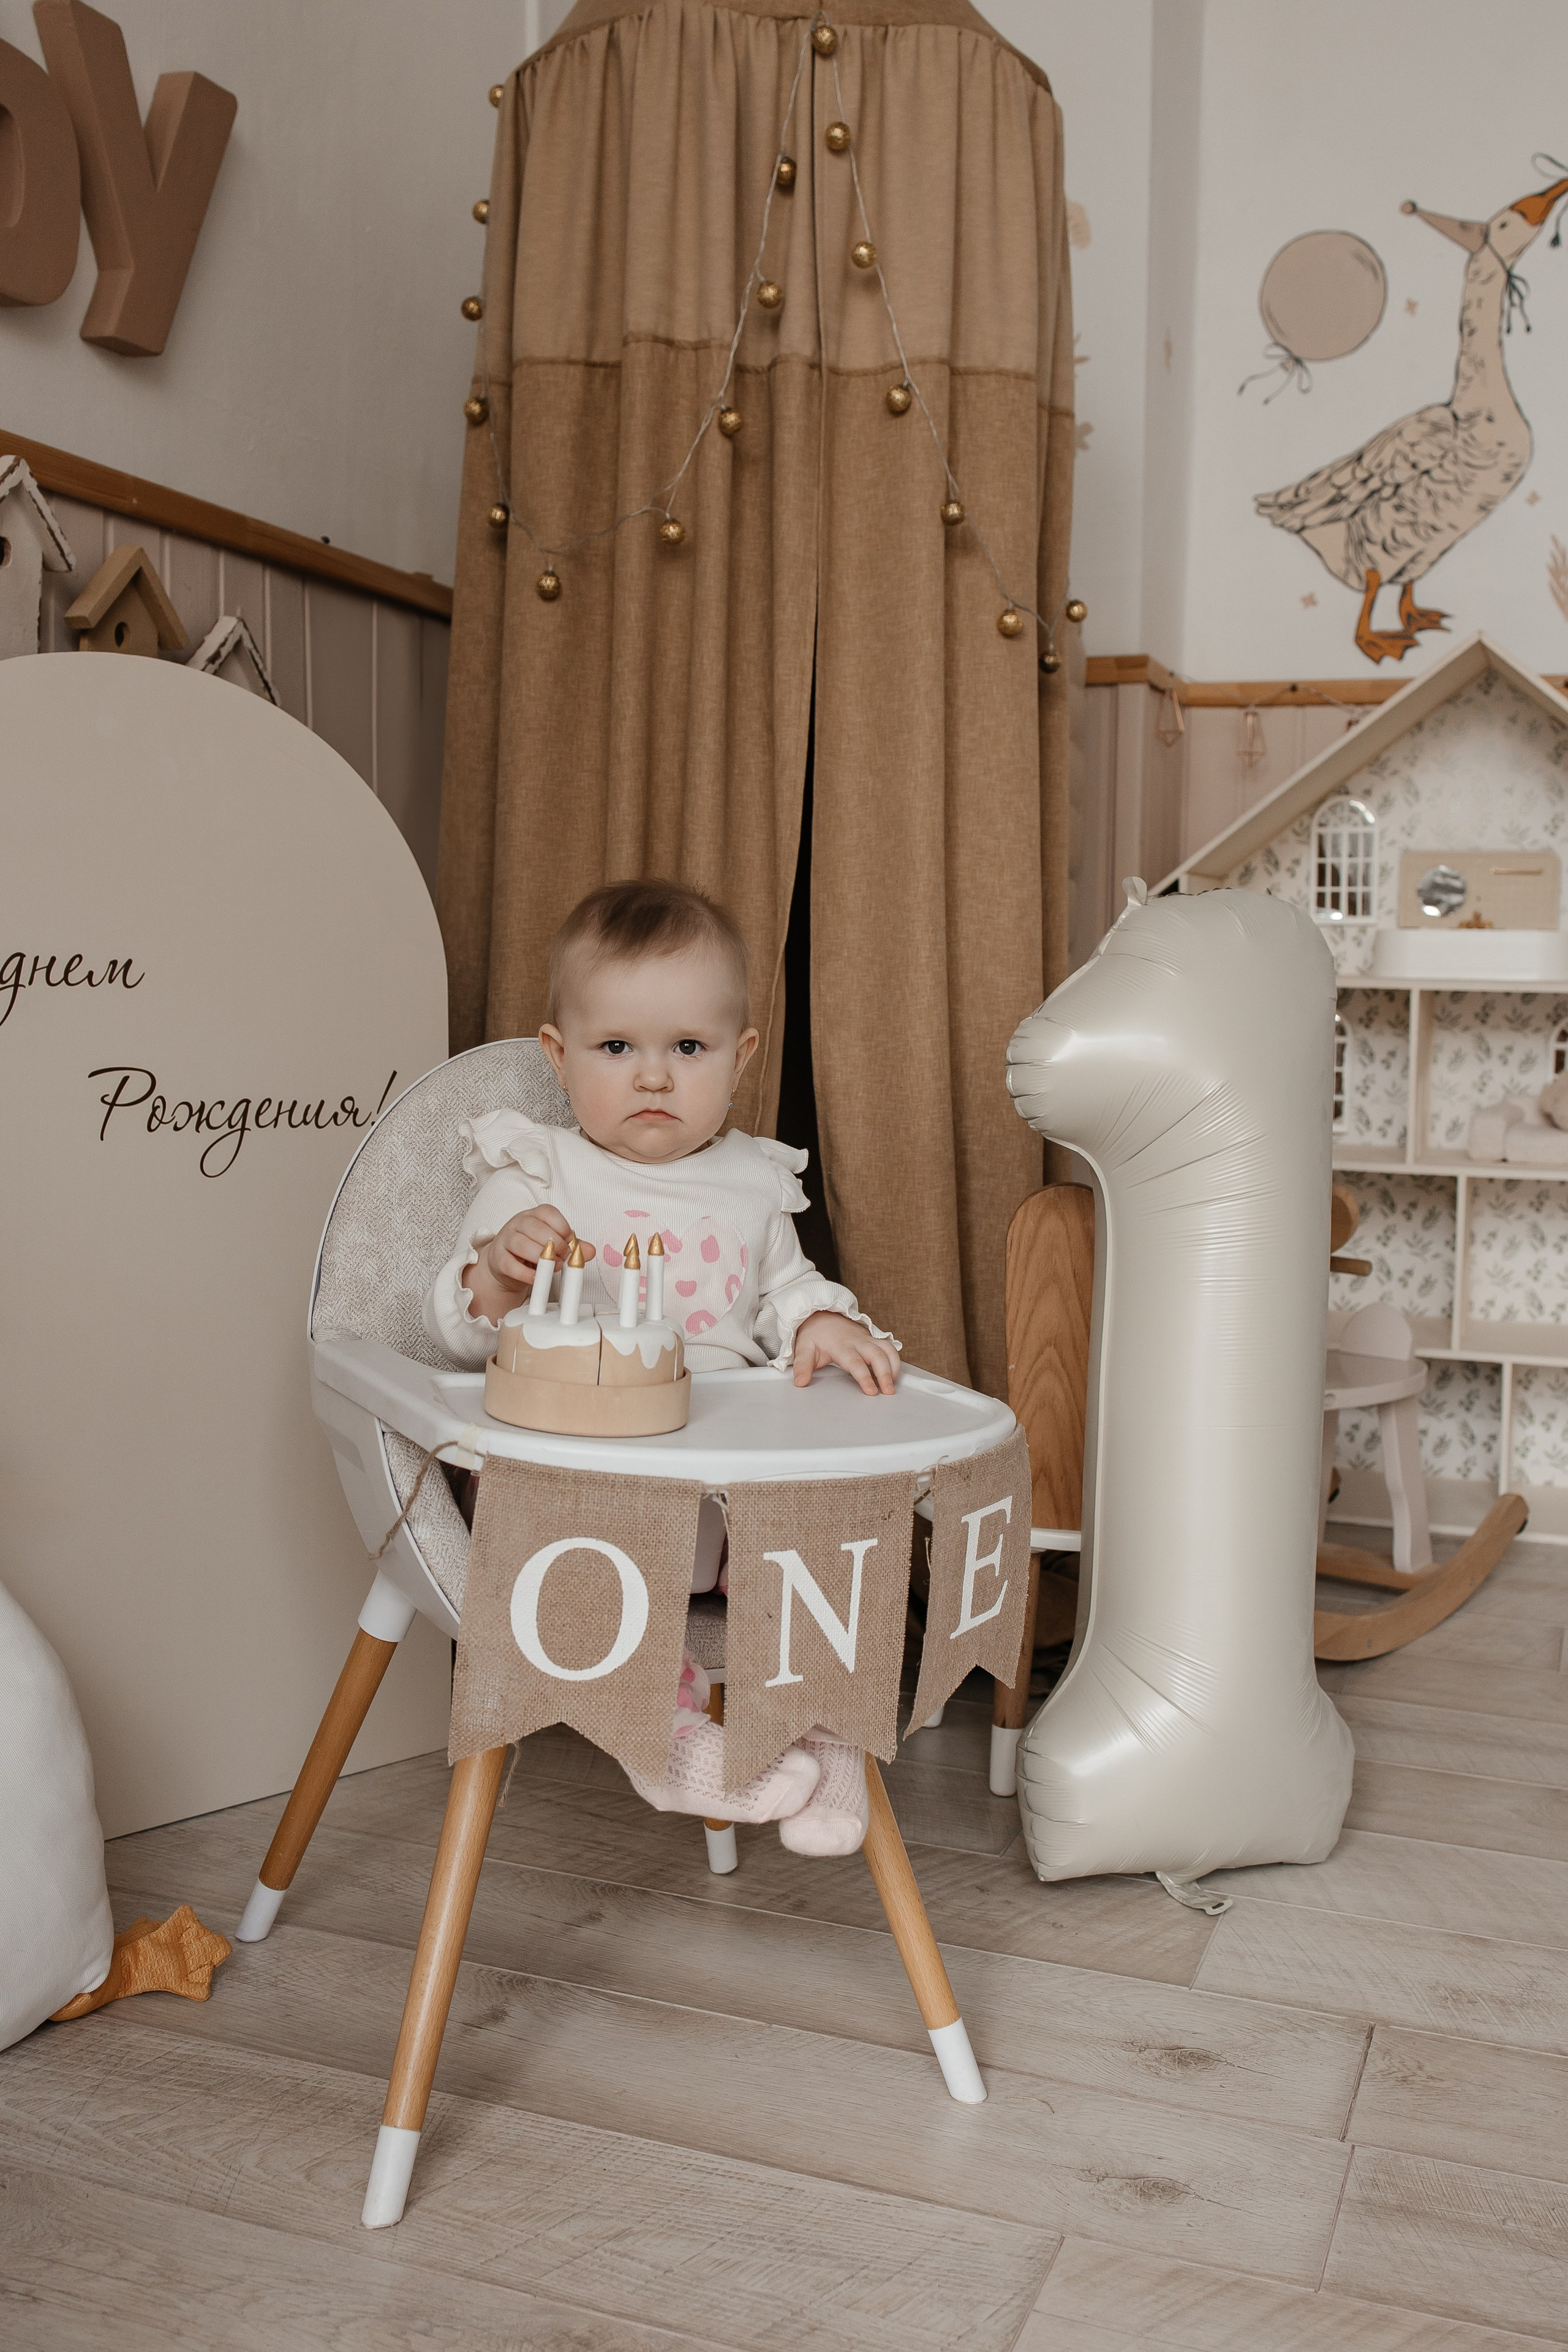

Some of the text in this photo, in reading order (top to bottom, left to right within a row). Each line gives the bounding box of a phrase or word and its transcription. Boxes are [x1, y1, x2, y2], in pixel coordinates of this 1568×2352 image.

[0, 952, 145, 1027] днем
[88, 1066, 398, 1178] Рождения!
[510, 1494, 1013, 1687] ONE
